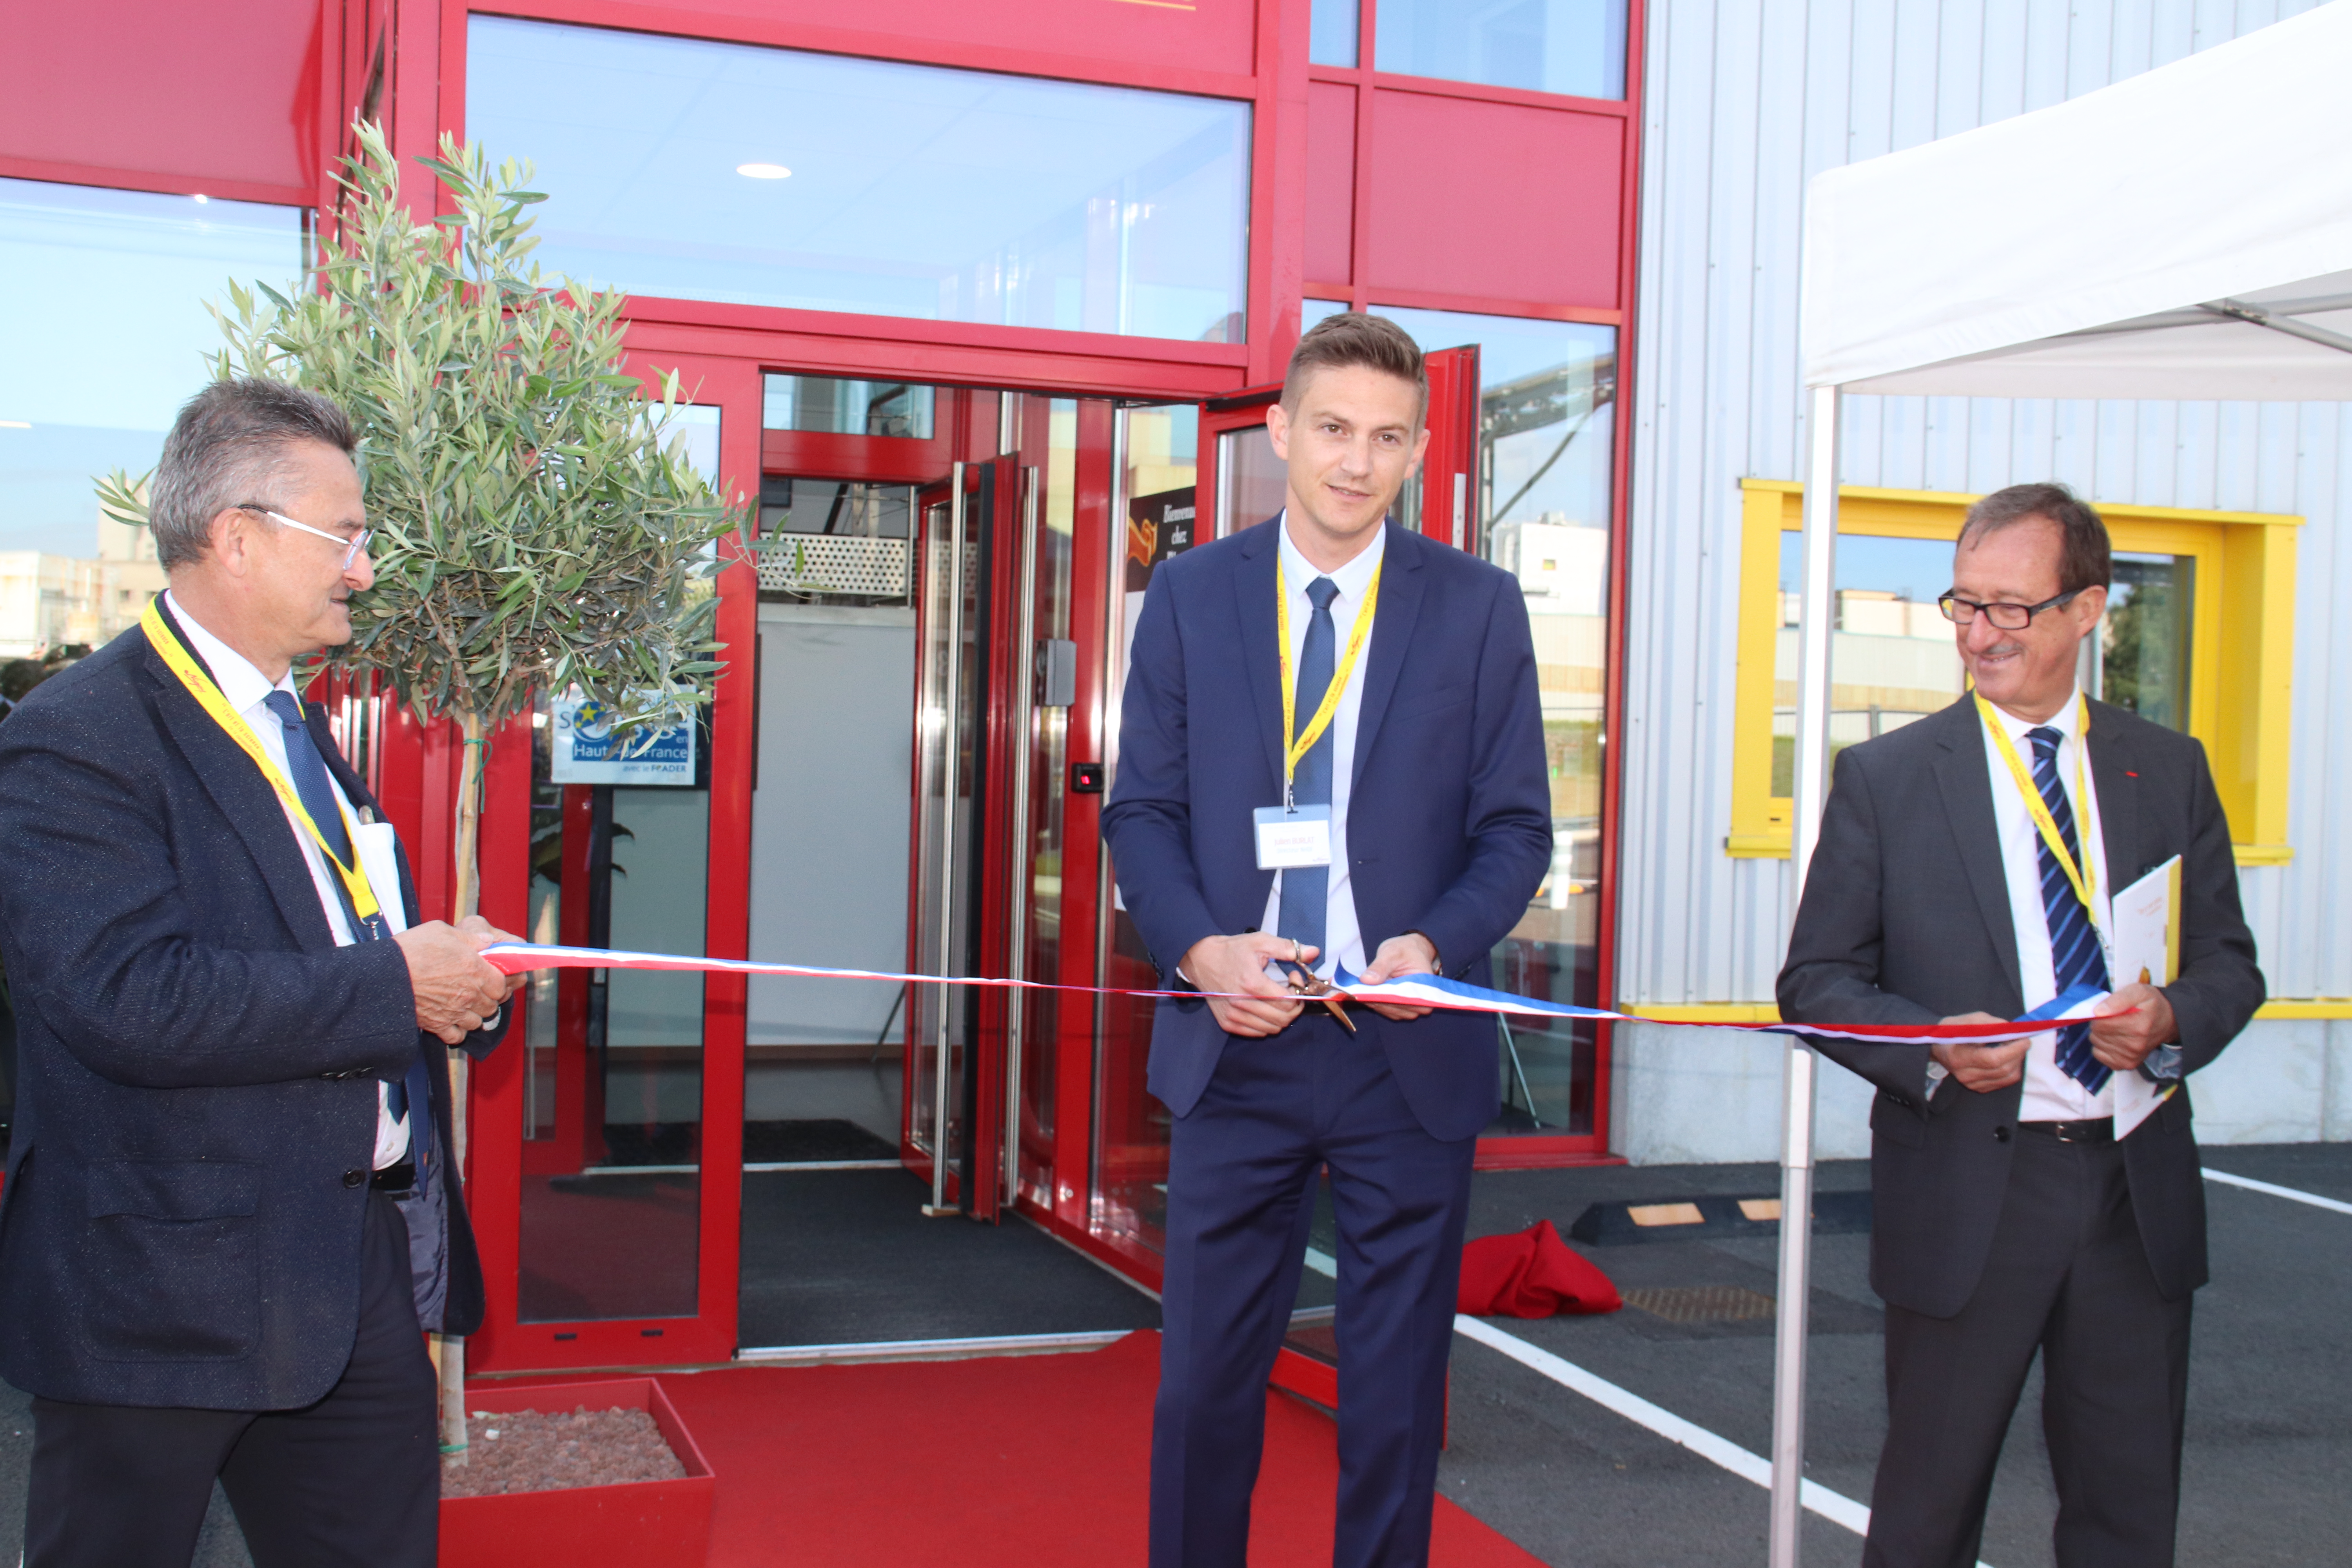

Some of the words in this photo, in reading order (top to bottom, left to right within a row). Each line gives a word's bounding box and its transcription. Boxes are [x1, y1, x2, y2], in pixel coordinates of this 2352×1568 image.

[1171, 525, 1187, 544] chez
[223, 709, 234, 720] L'art
[243, 732, 260, 749] science
